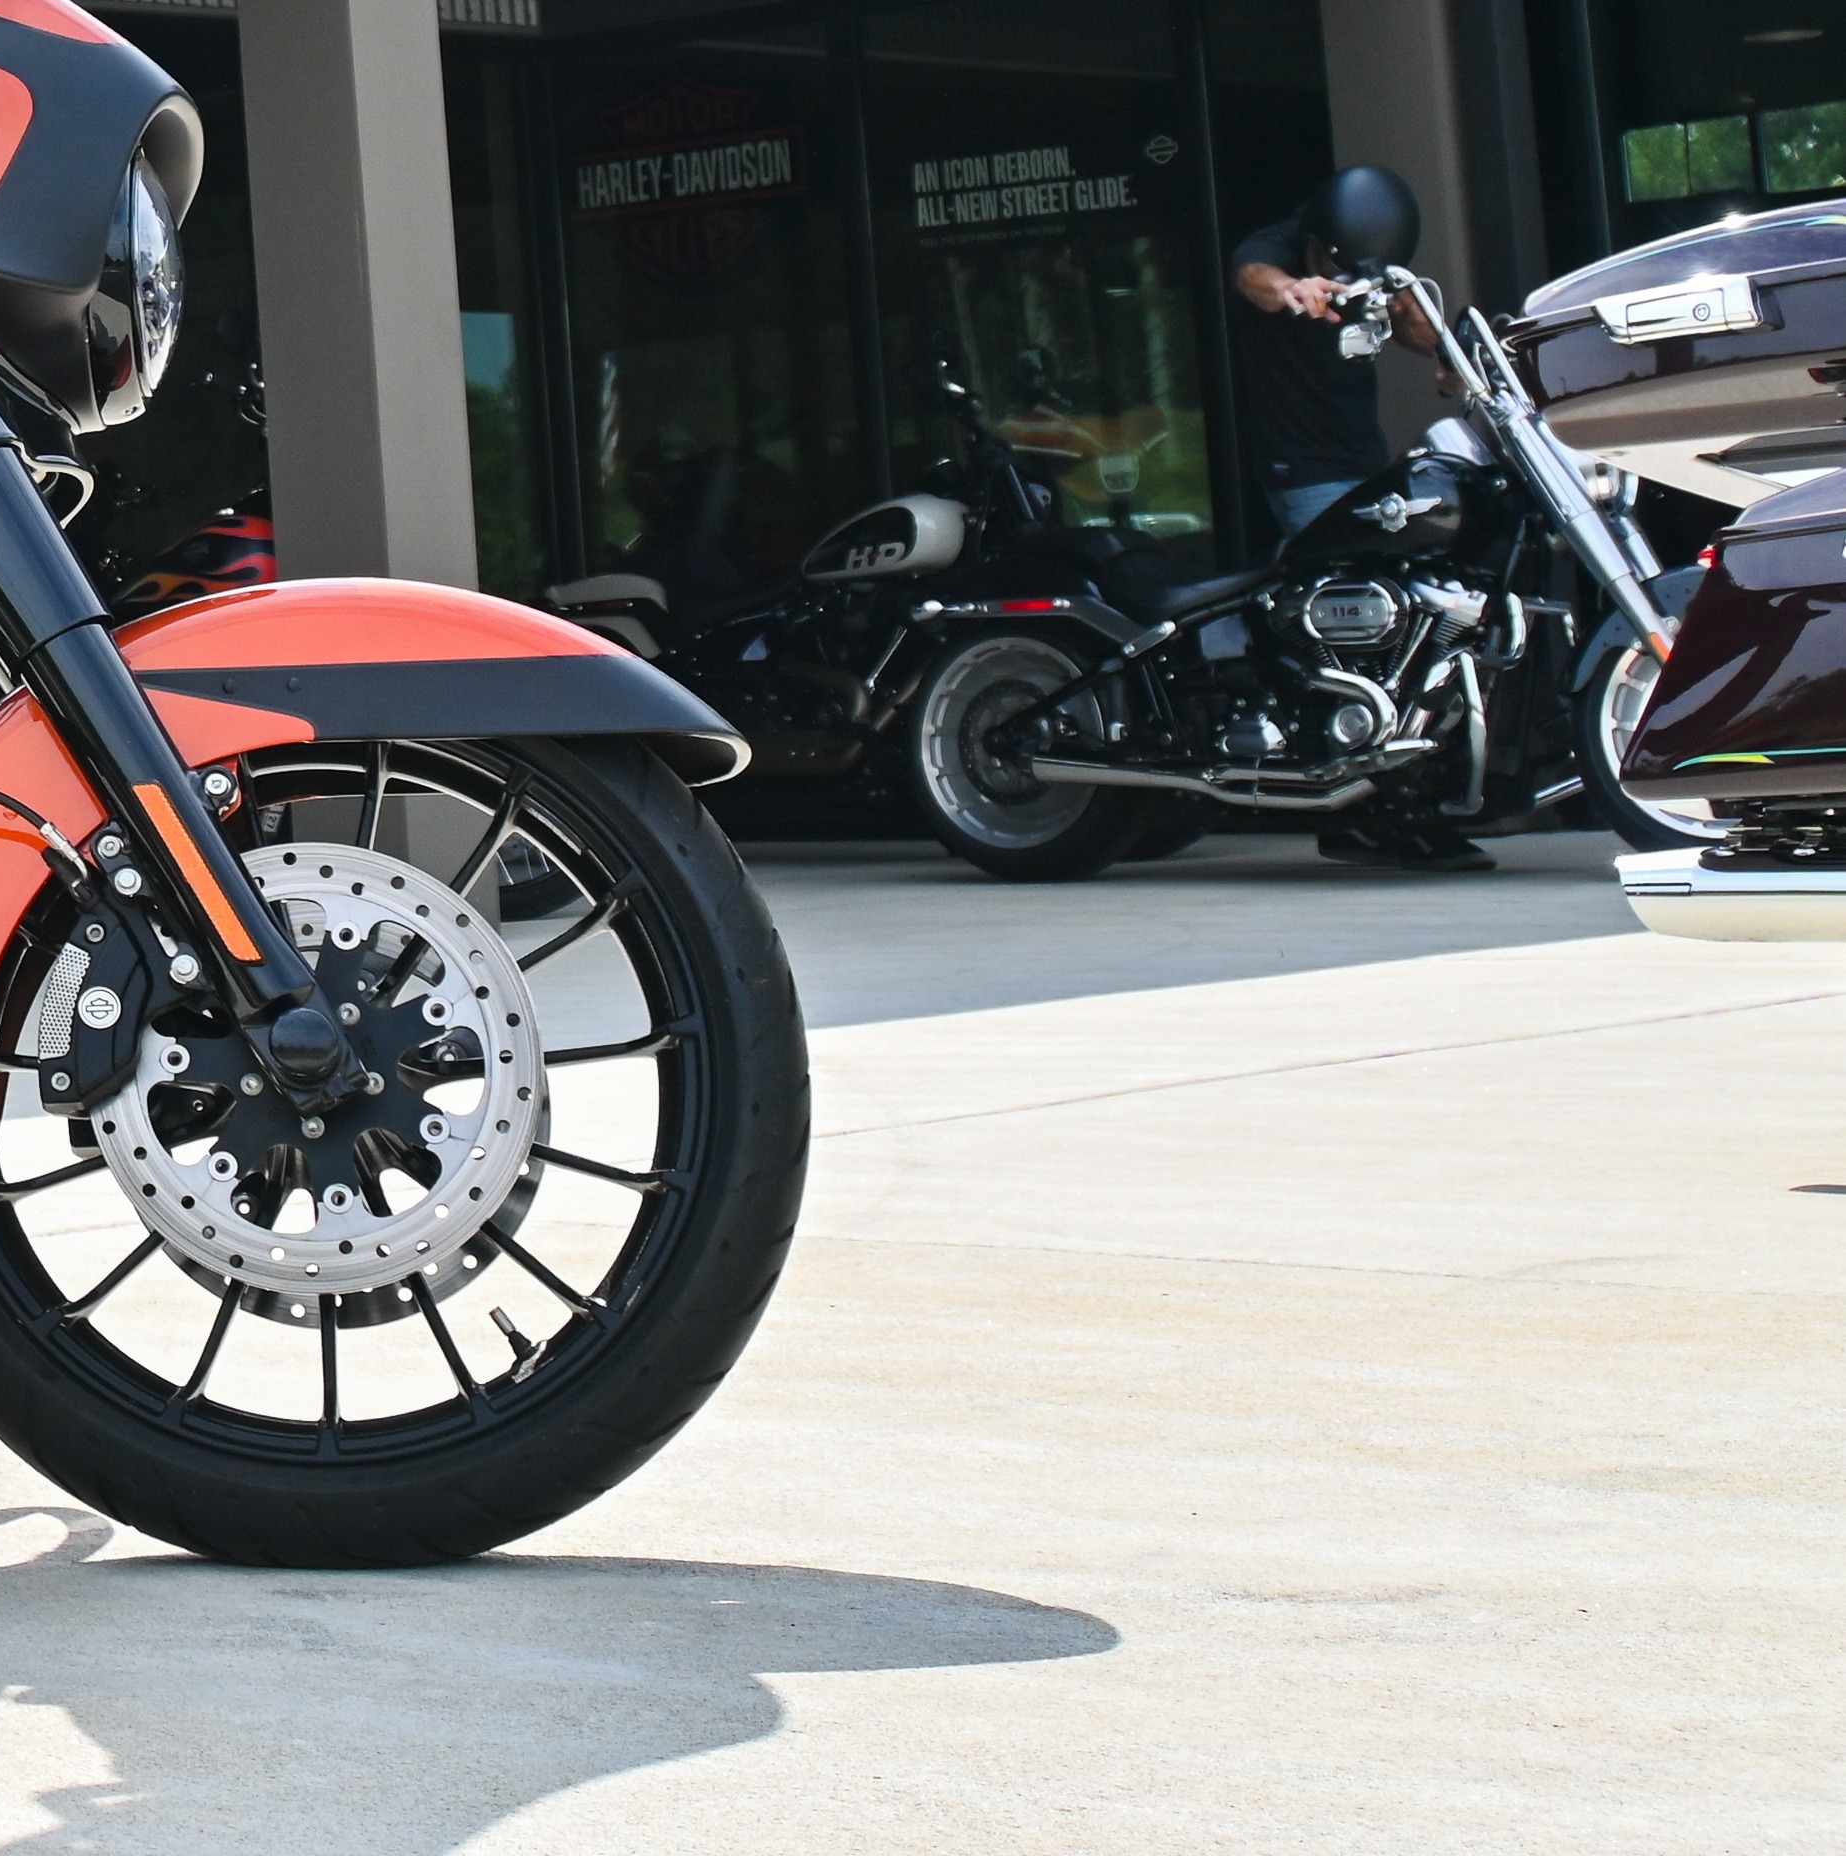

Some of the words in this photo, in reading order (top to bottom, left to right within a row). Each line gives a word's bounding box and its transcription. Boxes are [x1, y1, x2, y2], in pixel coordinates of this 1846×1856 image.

[577, 138, 793, 210] HARLEY-DAVIDSON
[914, 161, 941, 193] AN
[943, 156, 990, 190] ICON
[993, 146, 1077, 184] REBORN.
[918, 190, 997, 227] ALL-NEW
[1001, 182, 1070, 220] STREET
[1073, 175, 1138, 211] GLIDE.
